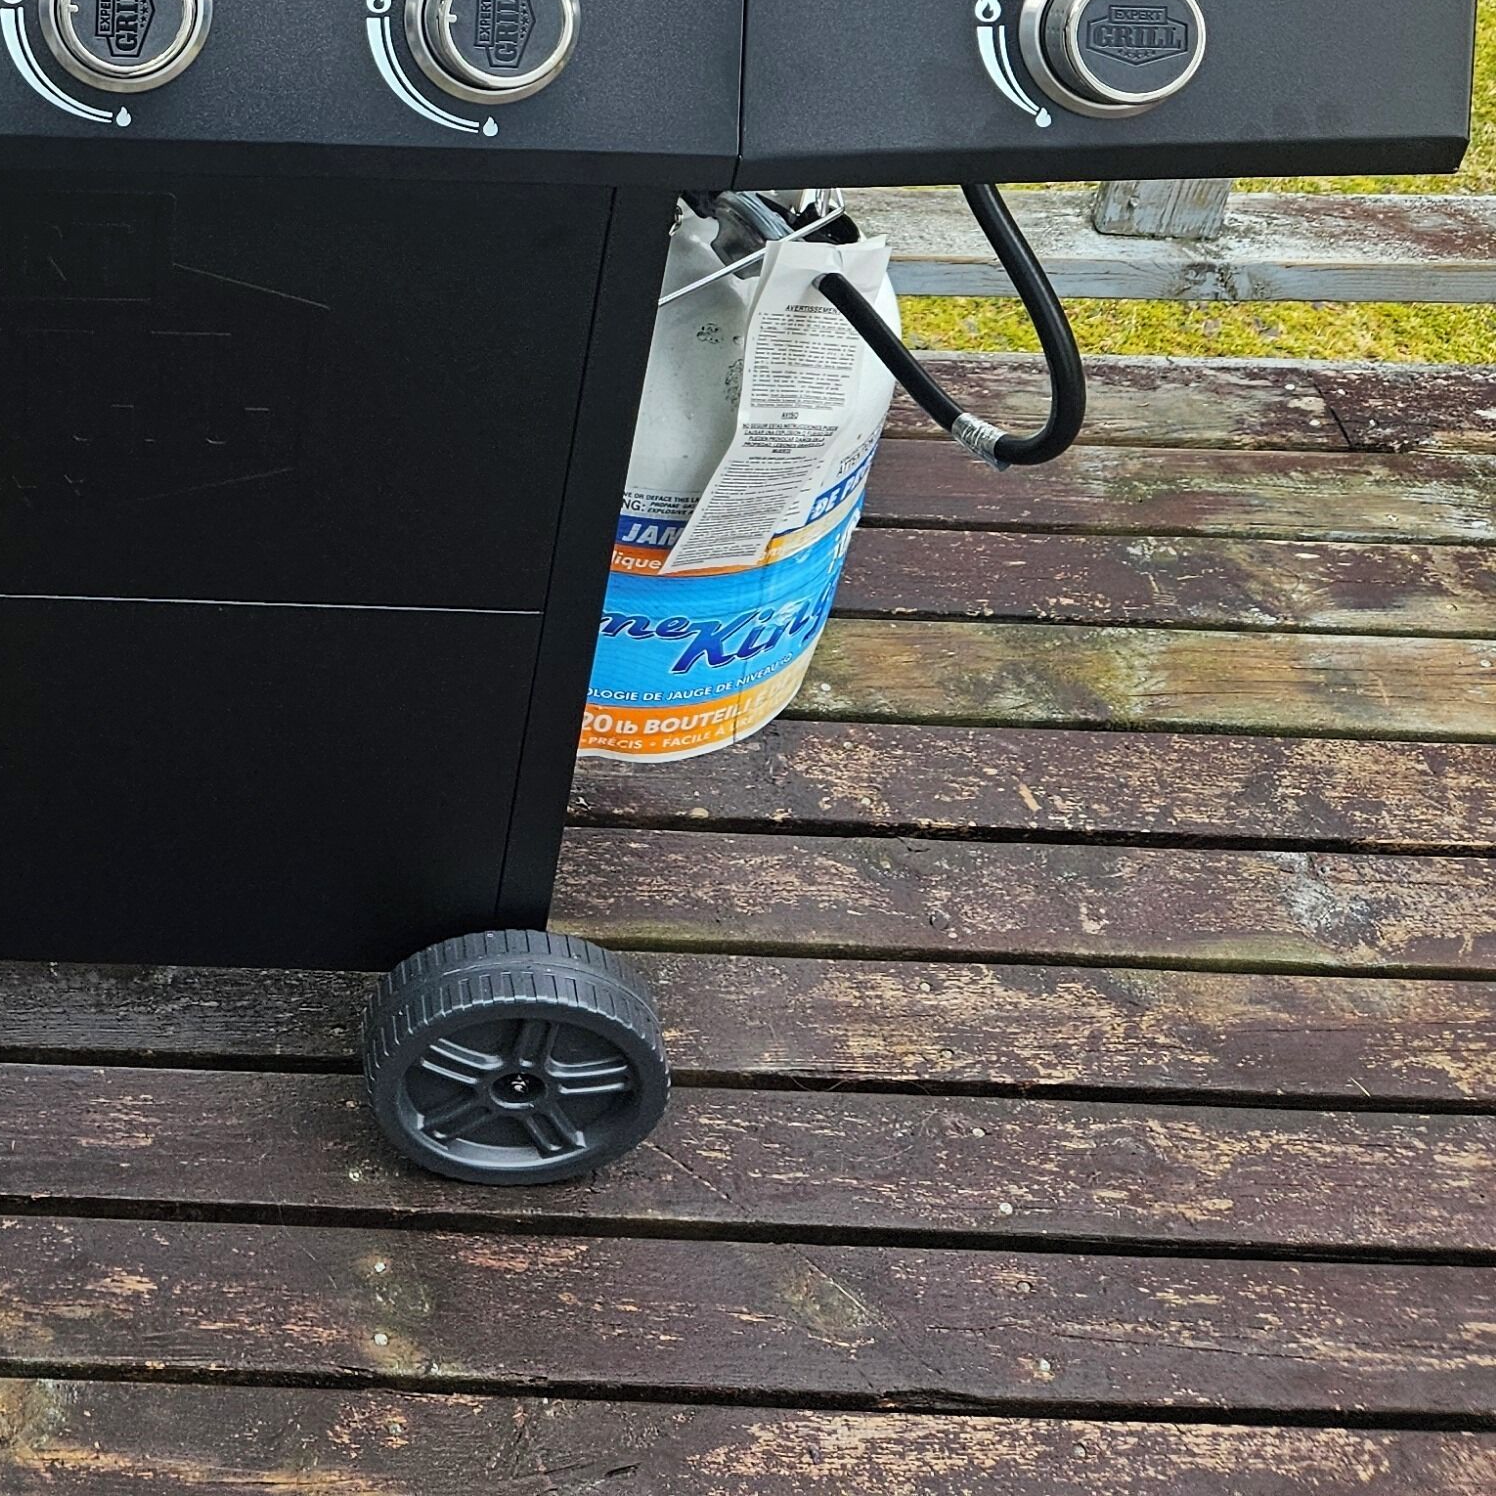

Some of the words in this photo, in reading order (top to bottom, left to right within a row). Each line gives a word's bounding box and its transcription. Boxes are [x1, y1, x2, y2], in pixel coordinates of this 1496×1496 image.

[1114, 9, 1162, 20] EXPERT
[1092, 25, 1182, 48] GRILL
[785, 304, 841, 316] AVERTISSEMEN
[646, 494, 672, 502] DEFACE
[642, 692, 662, 701] DE
[666, 686, 712, 700] JAUGE
[716, 681, 733, 693] DE
[736, 662, 780, 687] NIVEAU
[615, 720, 639, 734] lb
[662, 730, 712, 748] FACILE
